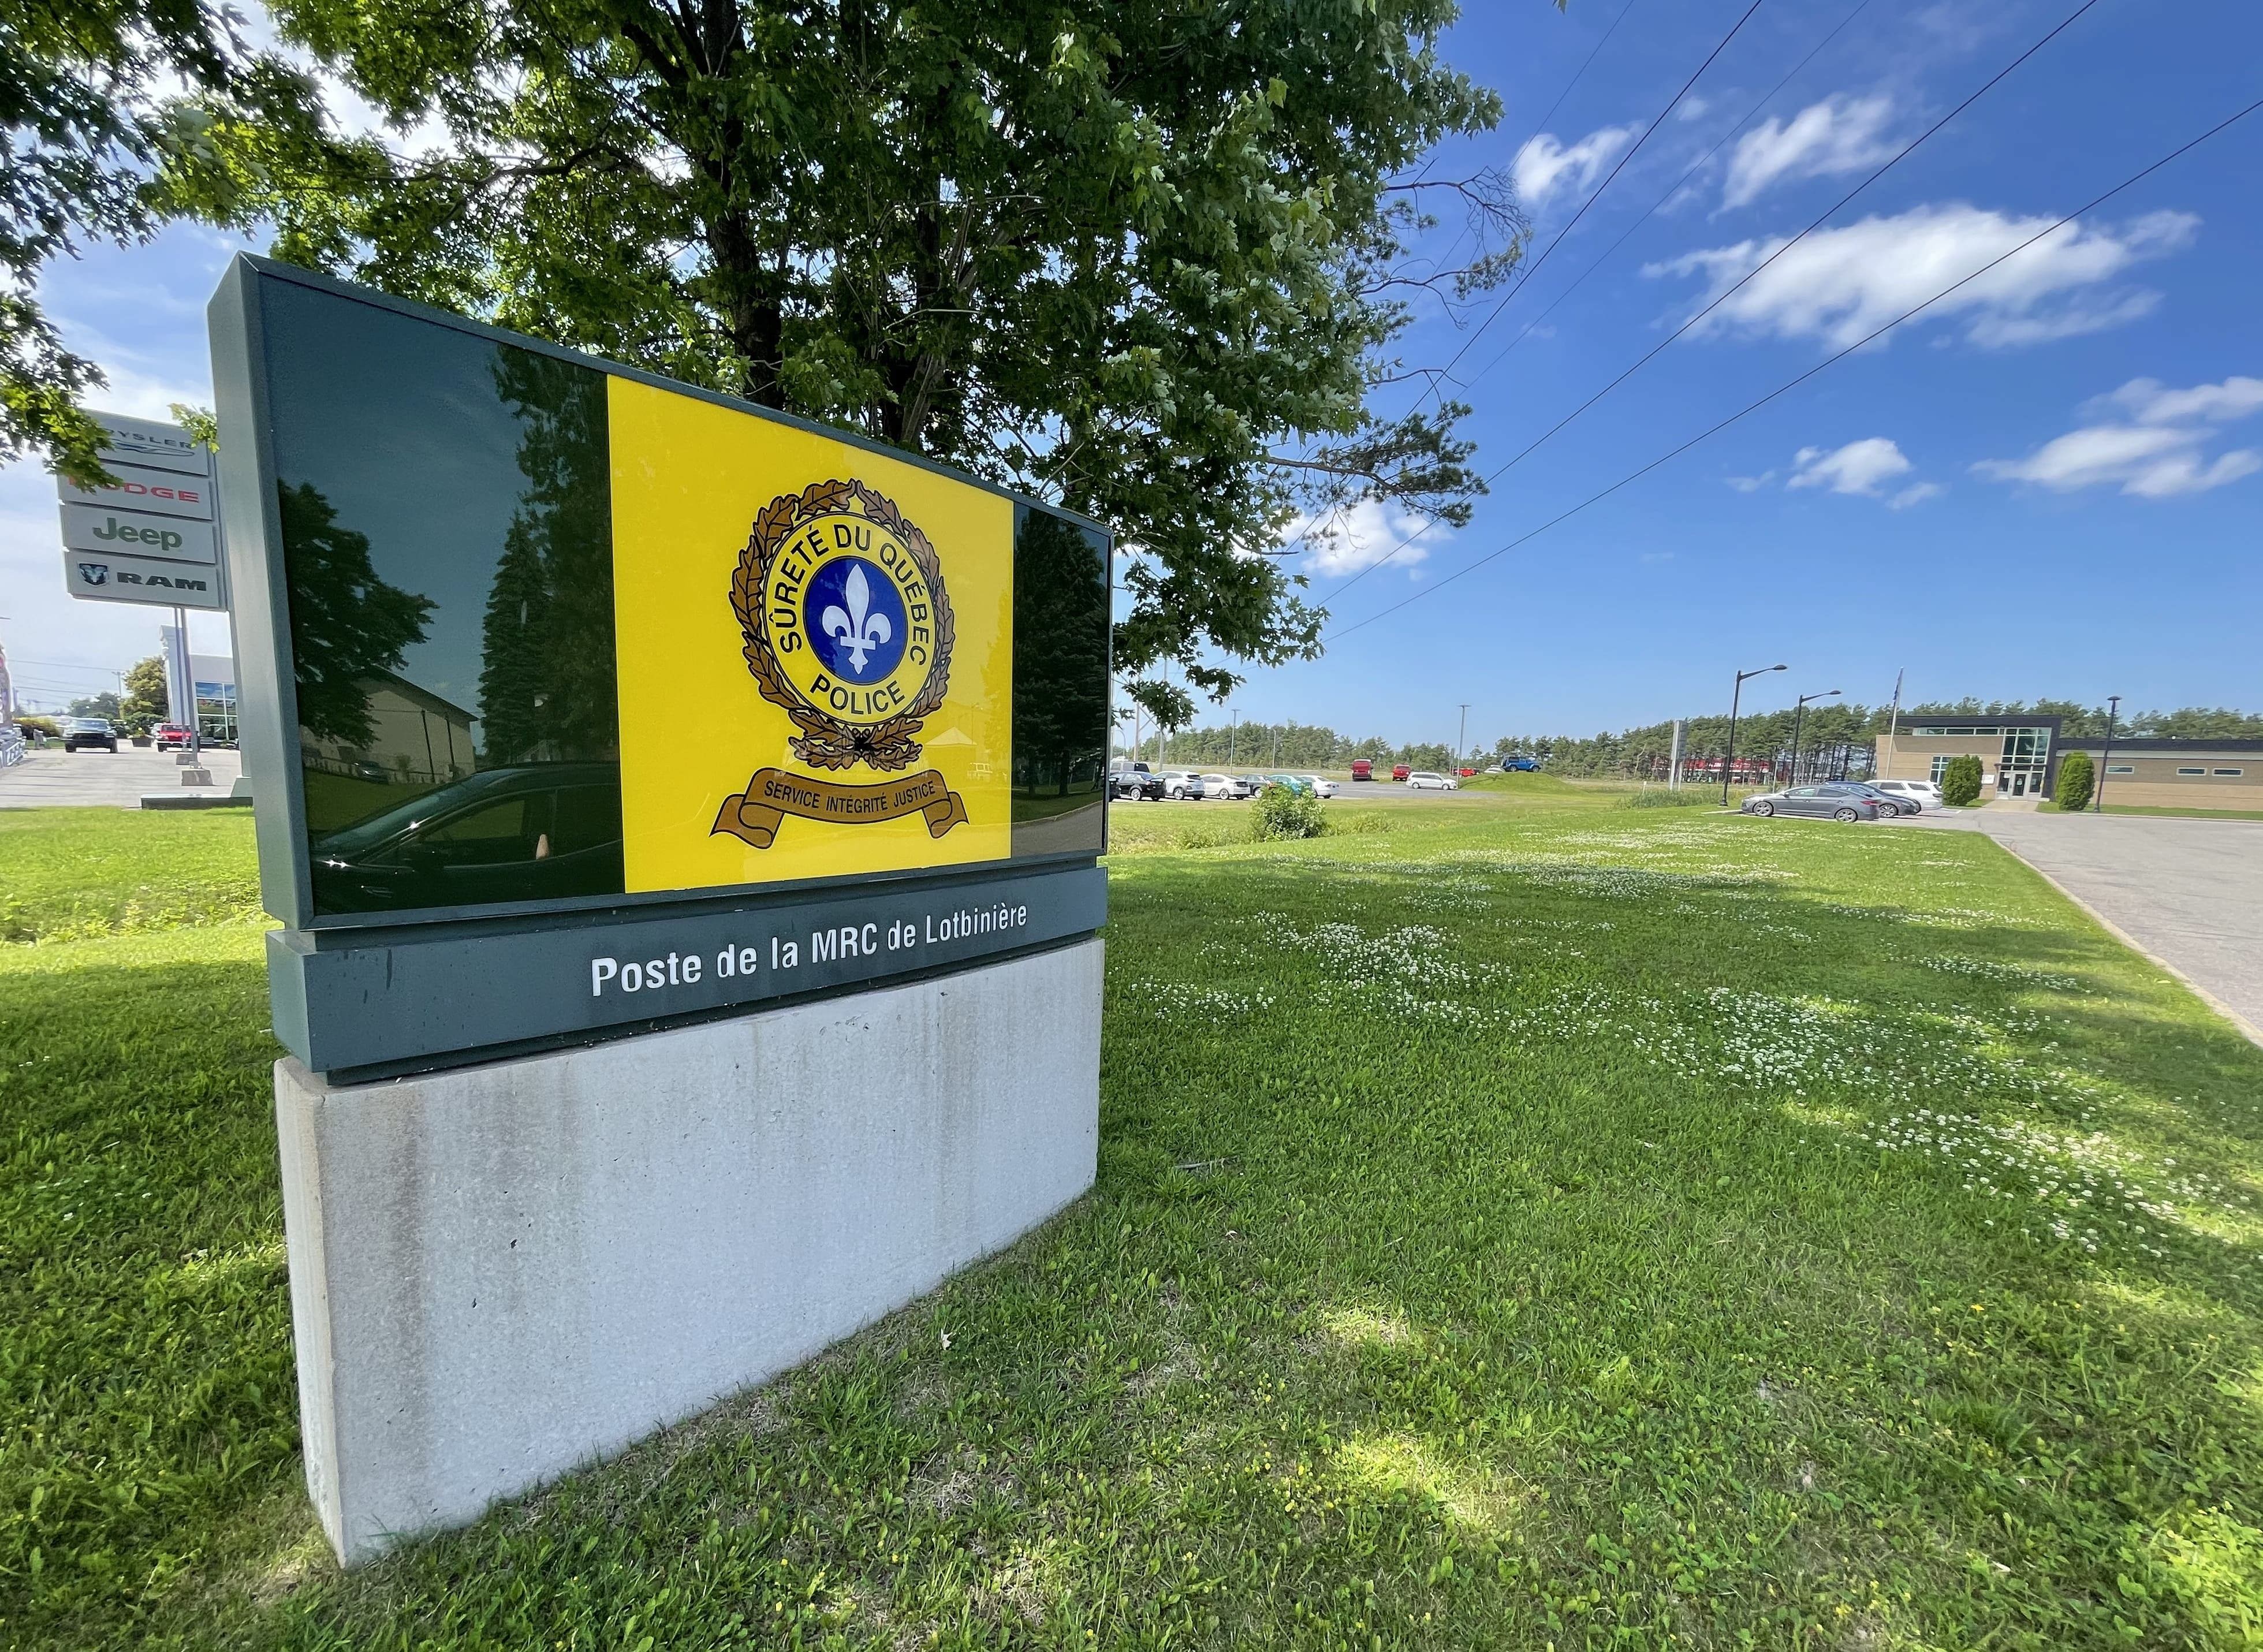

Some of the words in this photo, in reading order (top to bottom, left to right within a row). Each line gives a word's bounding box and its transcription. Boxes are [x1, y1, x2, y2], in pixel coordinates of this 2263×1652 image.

[92, 517, 183, 550] Jeep
[117, 572, 207, 591] RAM
[769, 524, 829, 653] SÛRETÉ
[834, 524, 871, 551] DU
[880, 543, 930, 666] QUÉBEC
[810, 673, 905, 715] POLICE
[764, 780, 820, 808] SERVICE
[826, 792, 888, 814] INTÉGRITÉ
[893, 781, 935, 808] JUSTICE
[591, 952, 702, 997] Poste
[717, 944, 757, 978] de
[771, 937, 798, 969] la
[811, 923, 877, 963] MRC
[888, 920, 916, 950] de
[926, 903, 1027, 944] Lotbinière
